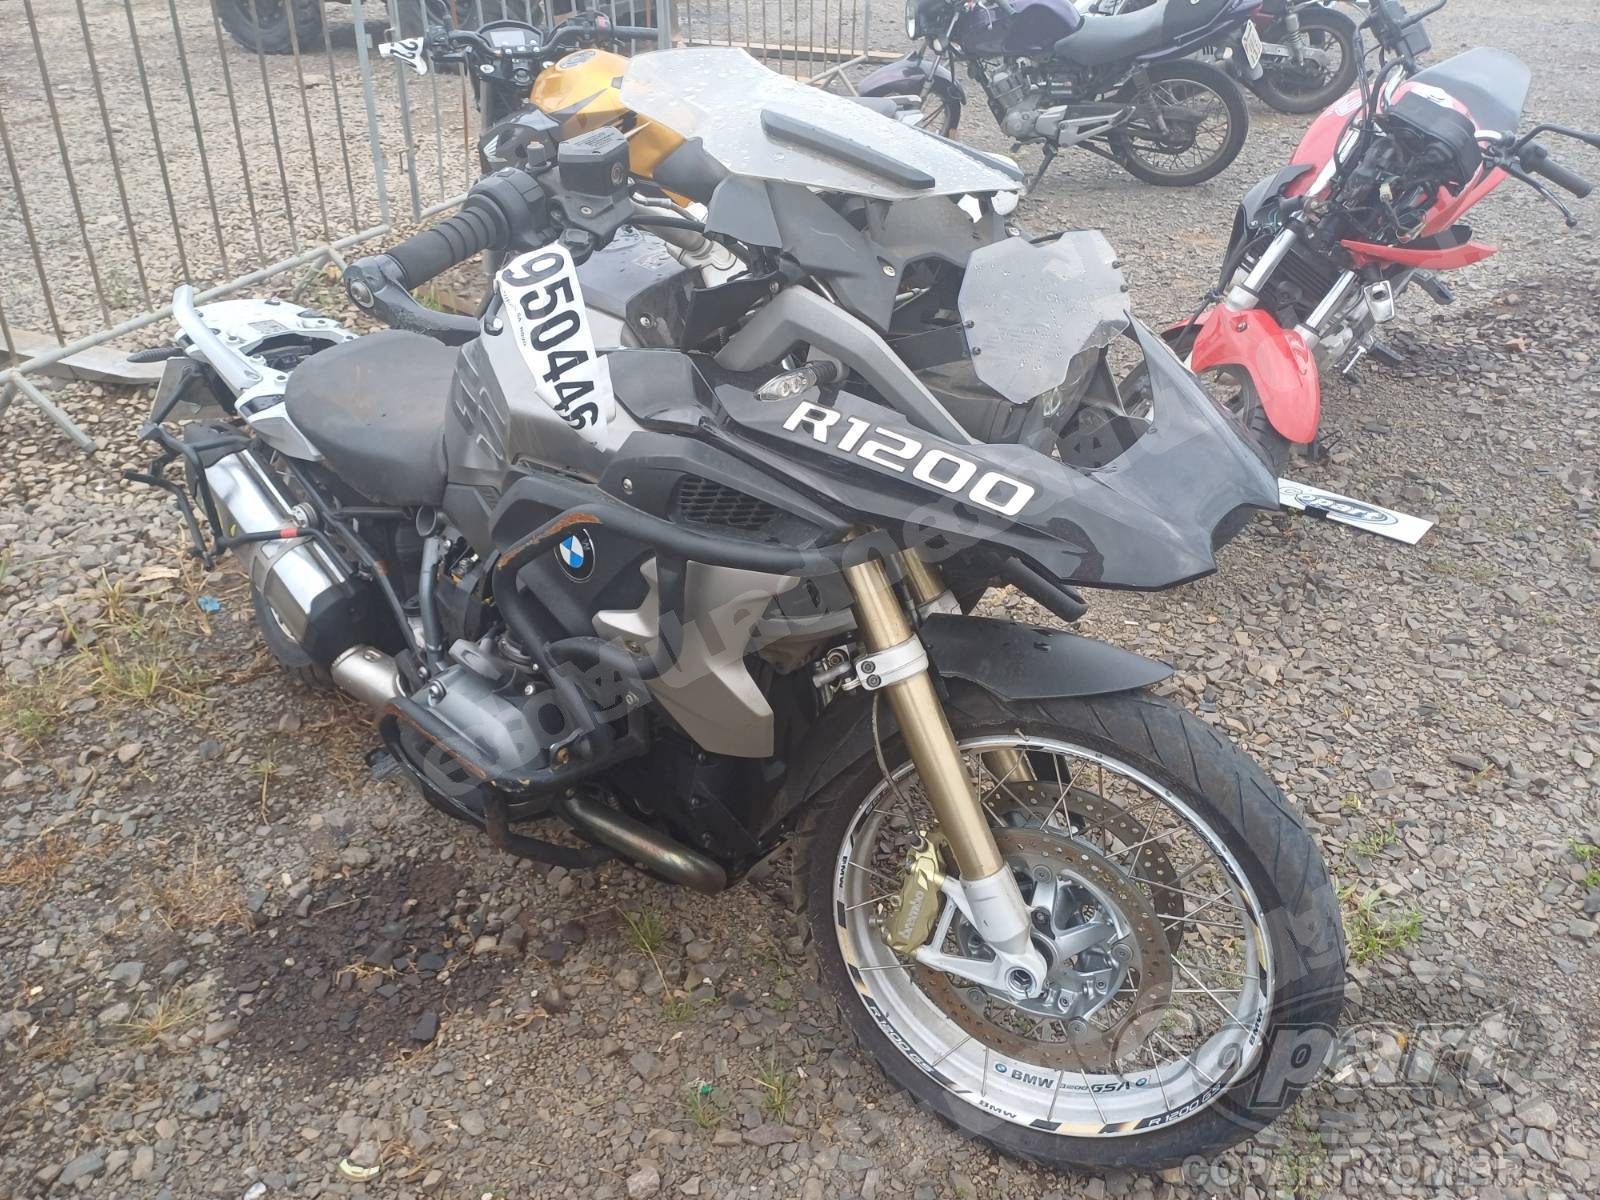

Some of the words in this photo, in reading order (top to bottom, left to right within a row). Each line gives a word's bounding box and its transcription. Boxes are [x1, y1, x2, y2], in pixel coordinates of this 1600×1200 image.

[501, 252, 599, 431] 950446
[782, 401, 1035, 516] R1200
[1248, 1007, 1263, 1046] BMW
[1011, 1069, 1054, 1089] BMW
[1091, 1081, 1130, 1093] GSA
[979, 1099, 1017, 1119] BMW
[1148, 1118, 1162, 1128] R
[1164, 1100, 1200, 1123] 1200
